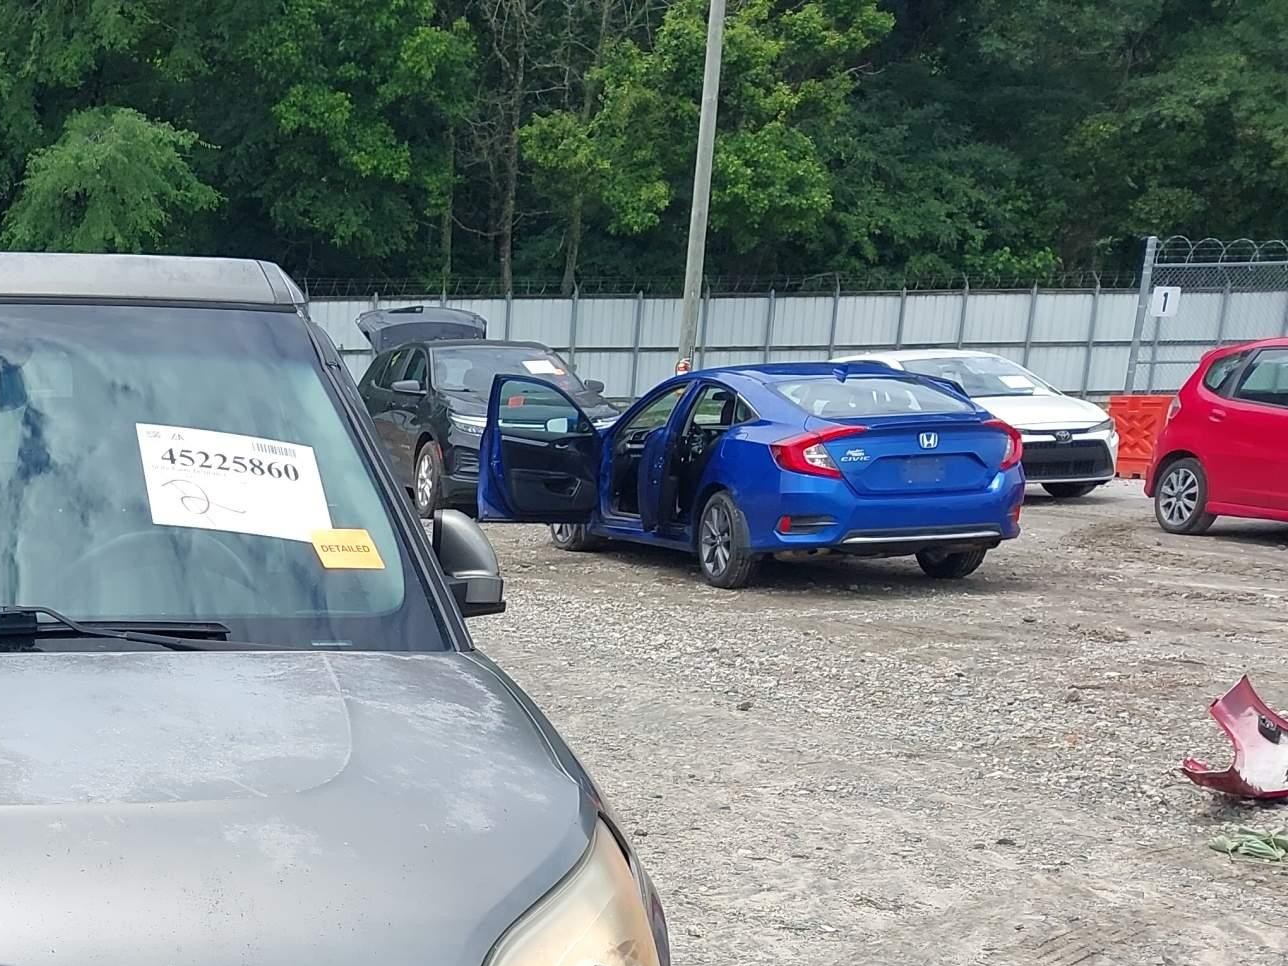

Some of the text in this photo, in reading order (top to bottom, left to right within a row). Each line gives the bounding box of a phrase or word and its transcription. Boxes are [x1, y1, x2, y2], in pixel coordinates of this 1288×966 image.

[1161, 291, 1170, 313] 1
[161, 447, 300, 481] 45225860
[320, 544, 371, 553] DETAILED
